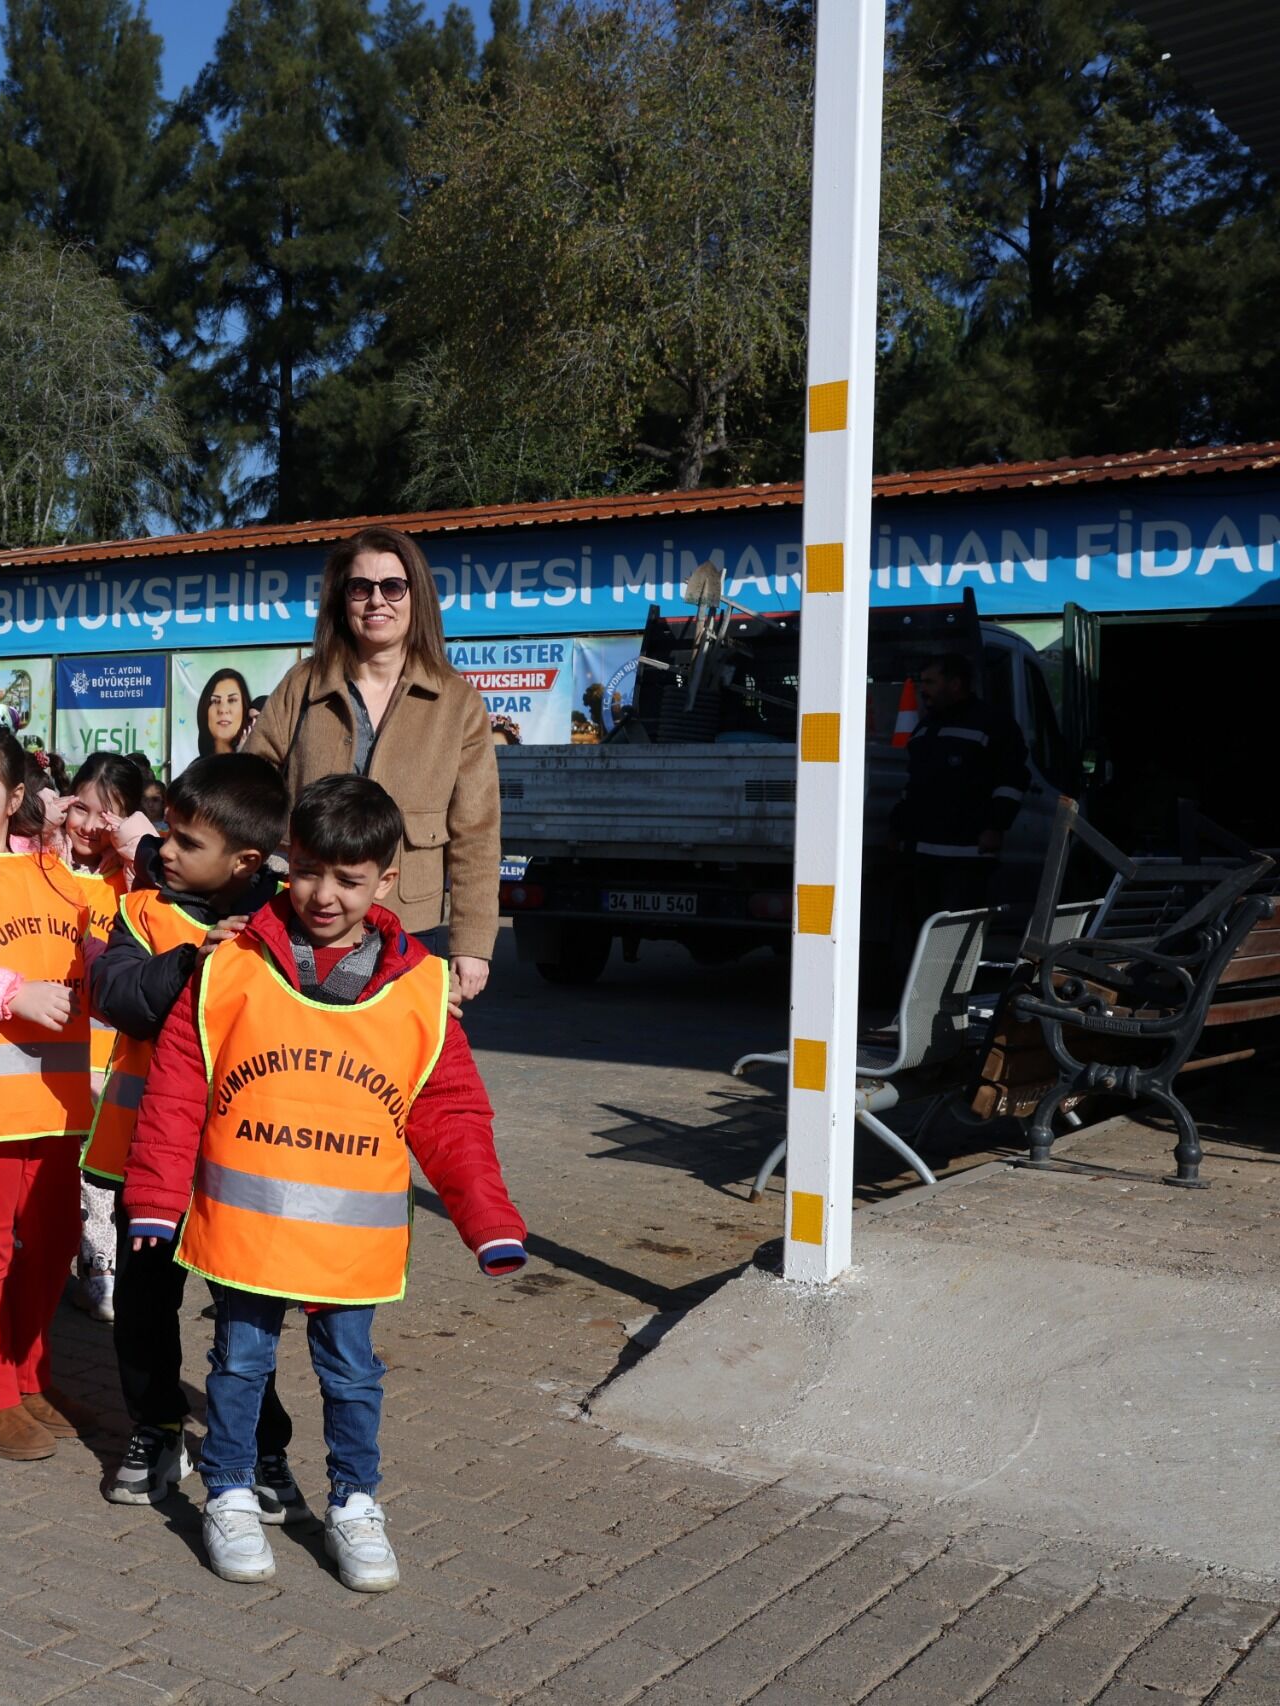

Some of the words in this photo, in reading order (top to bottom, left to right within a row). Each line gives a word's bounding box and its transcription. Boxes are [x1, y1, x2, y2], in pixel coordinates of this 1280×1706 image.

[869, 524, 1049, 591] İNAN
[103, 667, 117, 675] T.C.
[118, 666, 142, 675] AYDIN
[91, 675, 152, 689] BÜYÜKŞEHİR
[100, 688, 144, 698] BELEDİYESİ
[483, 696, 532, 713] APAR
[500, 866, 526, 876] ZLEM
[610, 893, 627, 909] 34
[633, 894, 660, 911] HLU
[666, 895, 695, 913] 540
[216, 1043, 333, 1117] CUMHURİYET
[235, 1119, 380, 1158] ANASINIFI
